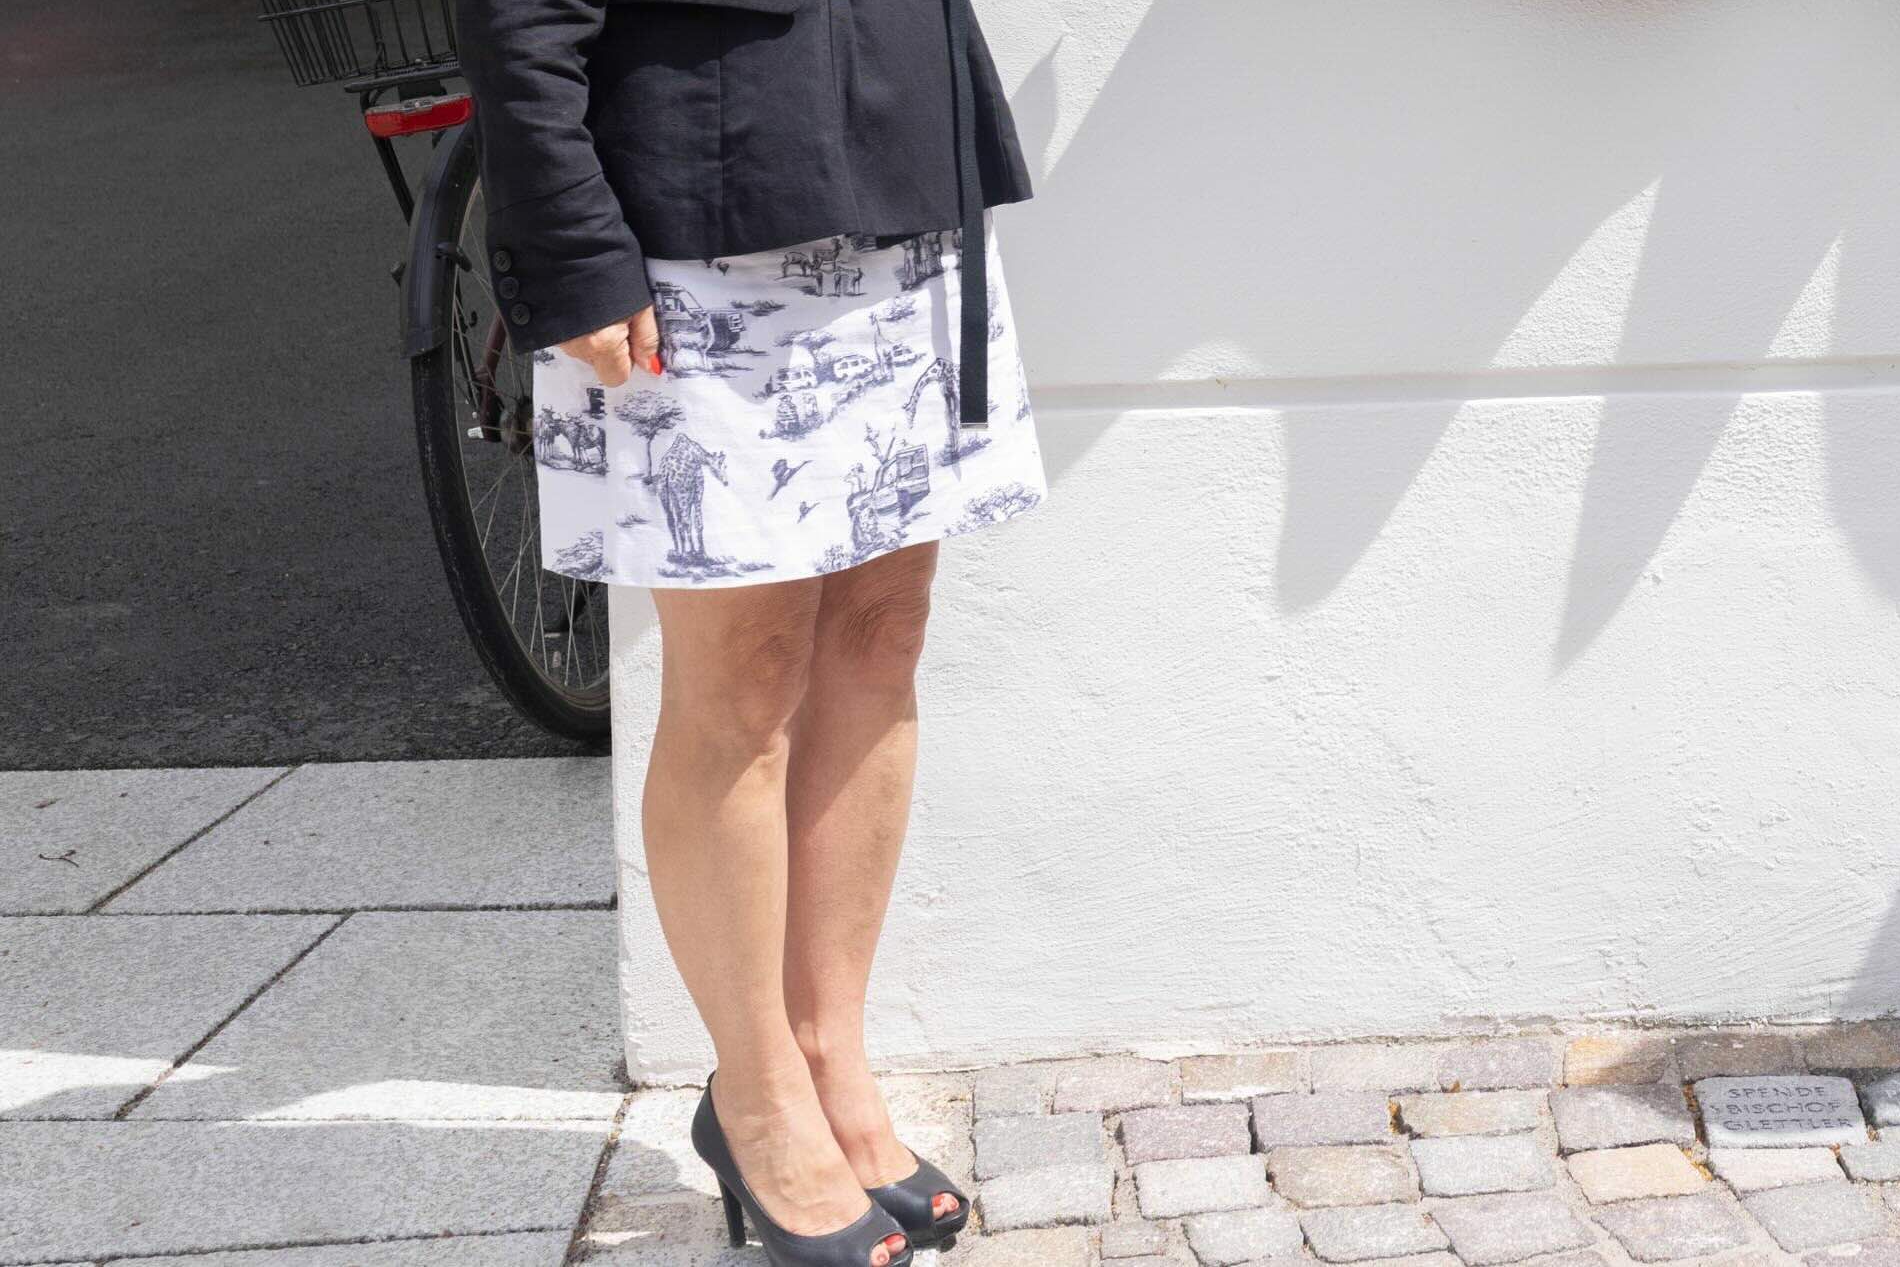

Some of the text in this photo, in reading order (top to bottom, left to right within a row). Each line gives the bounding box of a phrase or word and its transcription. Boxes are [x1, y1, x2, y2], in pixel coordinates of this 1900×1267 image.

[1728, 1086, 1825, 1099] SPENDE
[1726, 1102, 1841, 1115] BISCHOF
[1723, 1118, 1854, 1131] GLETTLER
